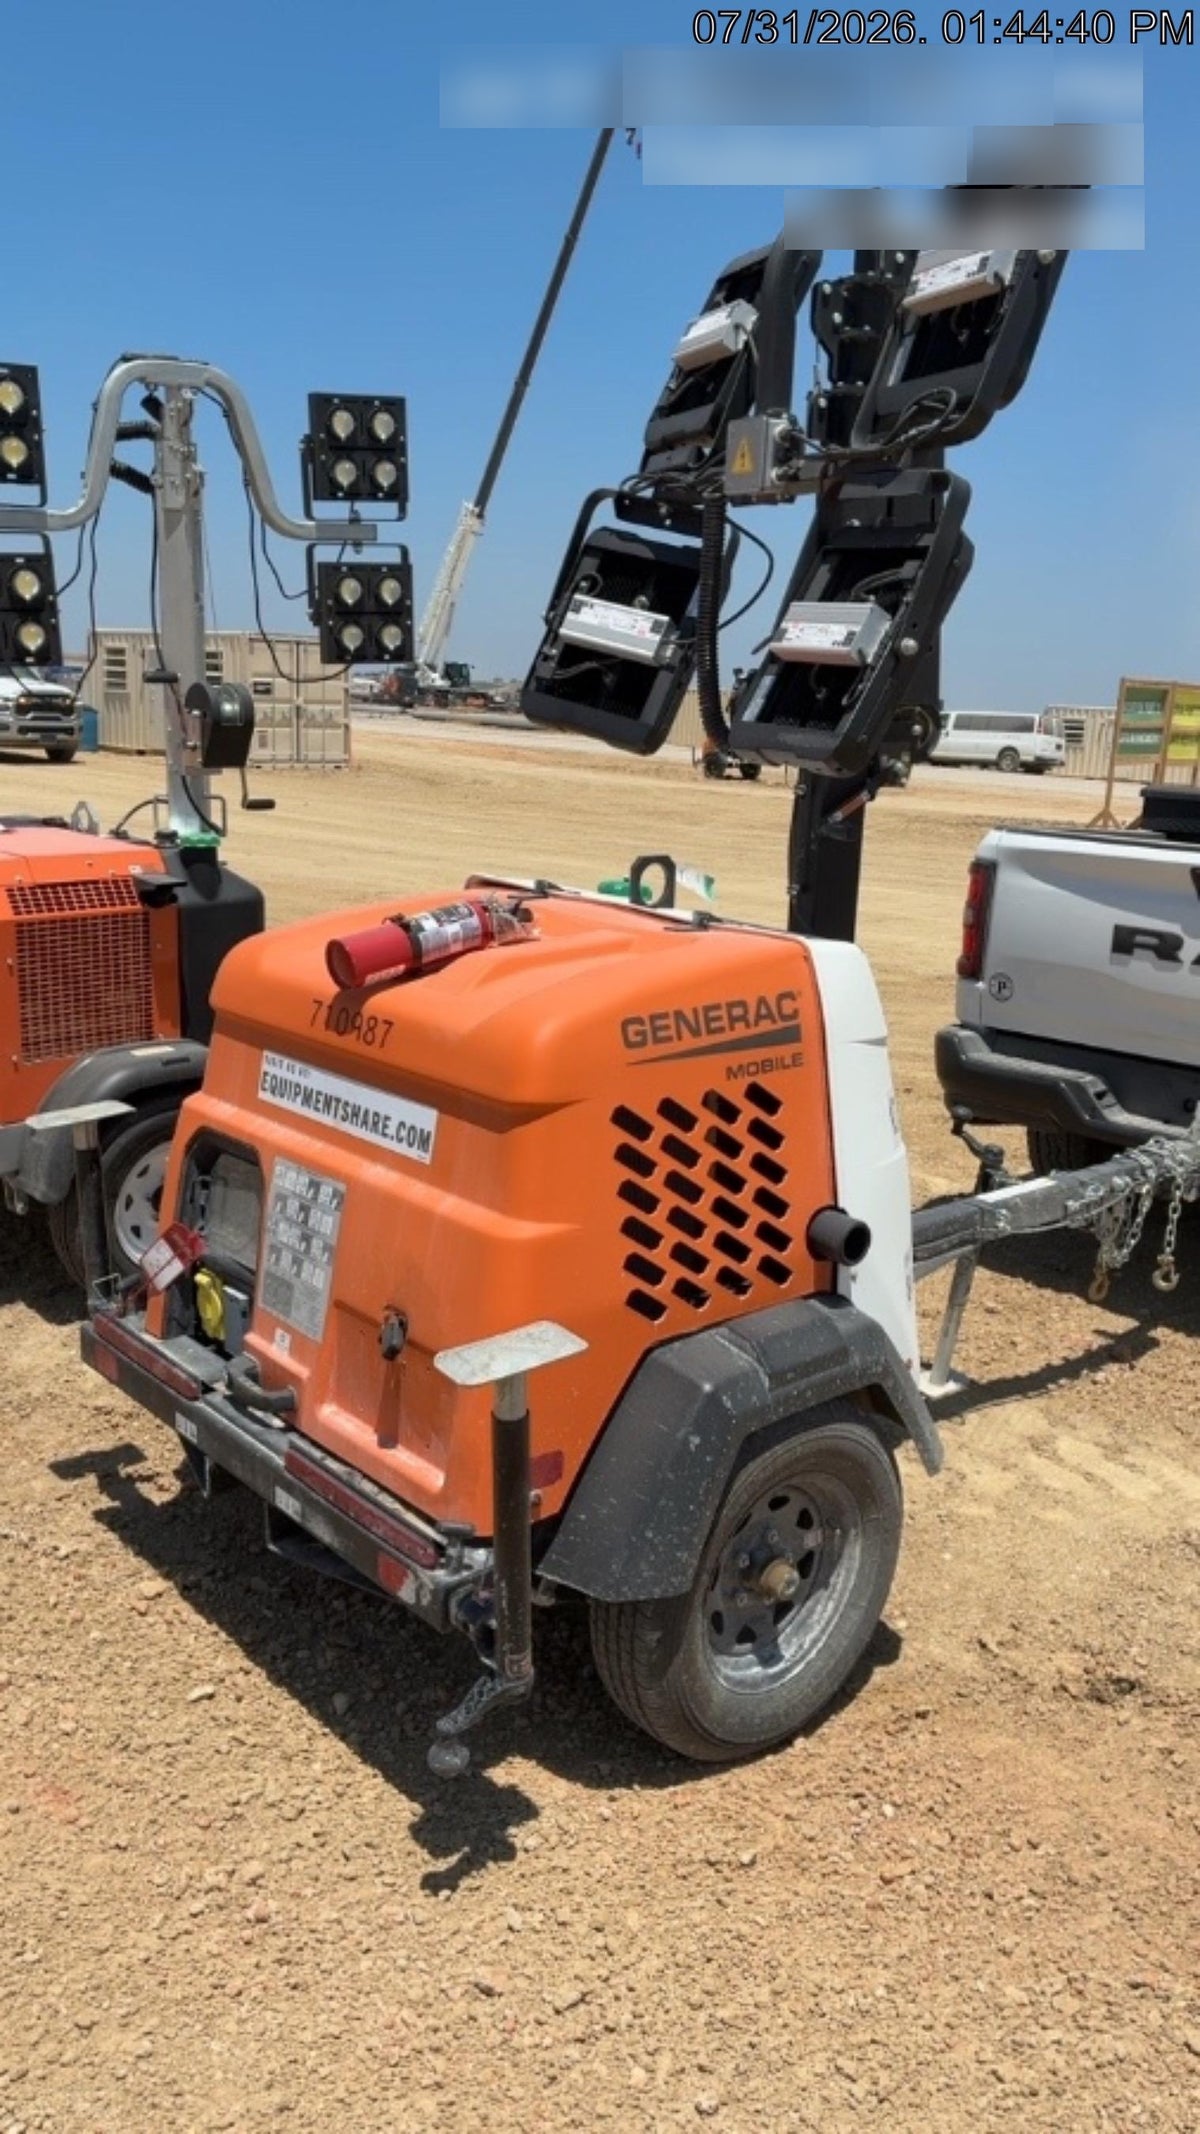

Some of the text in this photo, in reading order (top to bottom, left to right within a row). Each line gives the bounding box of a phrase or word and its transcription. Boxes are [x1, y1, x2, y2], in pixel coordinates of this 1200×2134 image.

[1112, 924, 1200, 965] R
[309, 1000, 395, 1049] 710987
[621, 991, 800, 1049] GENERAC
[726, 1052, 804, 1081] MOBILE
[260, 1071, 432, 1154] EQUIPMENTSHARE.COM
